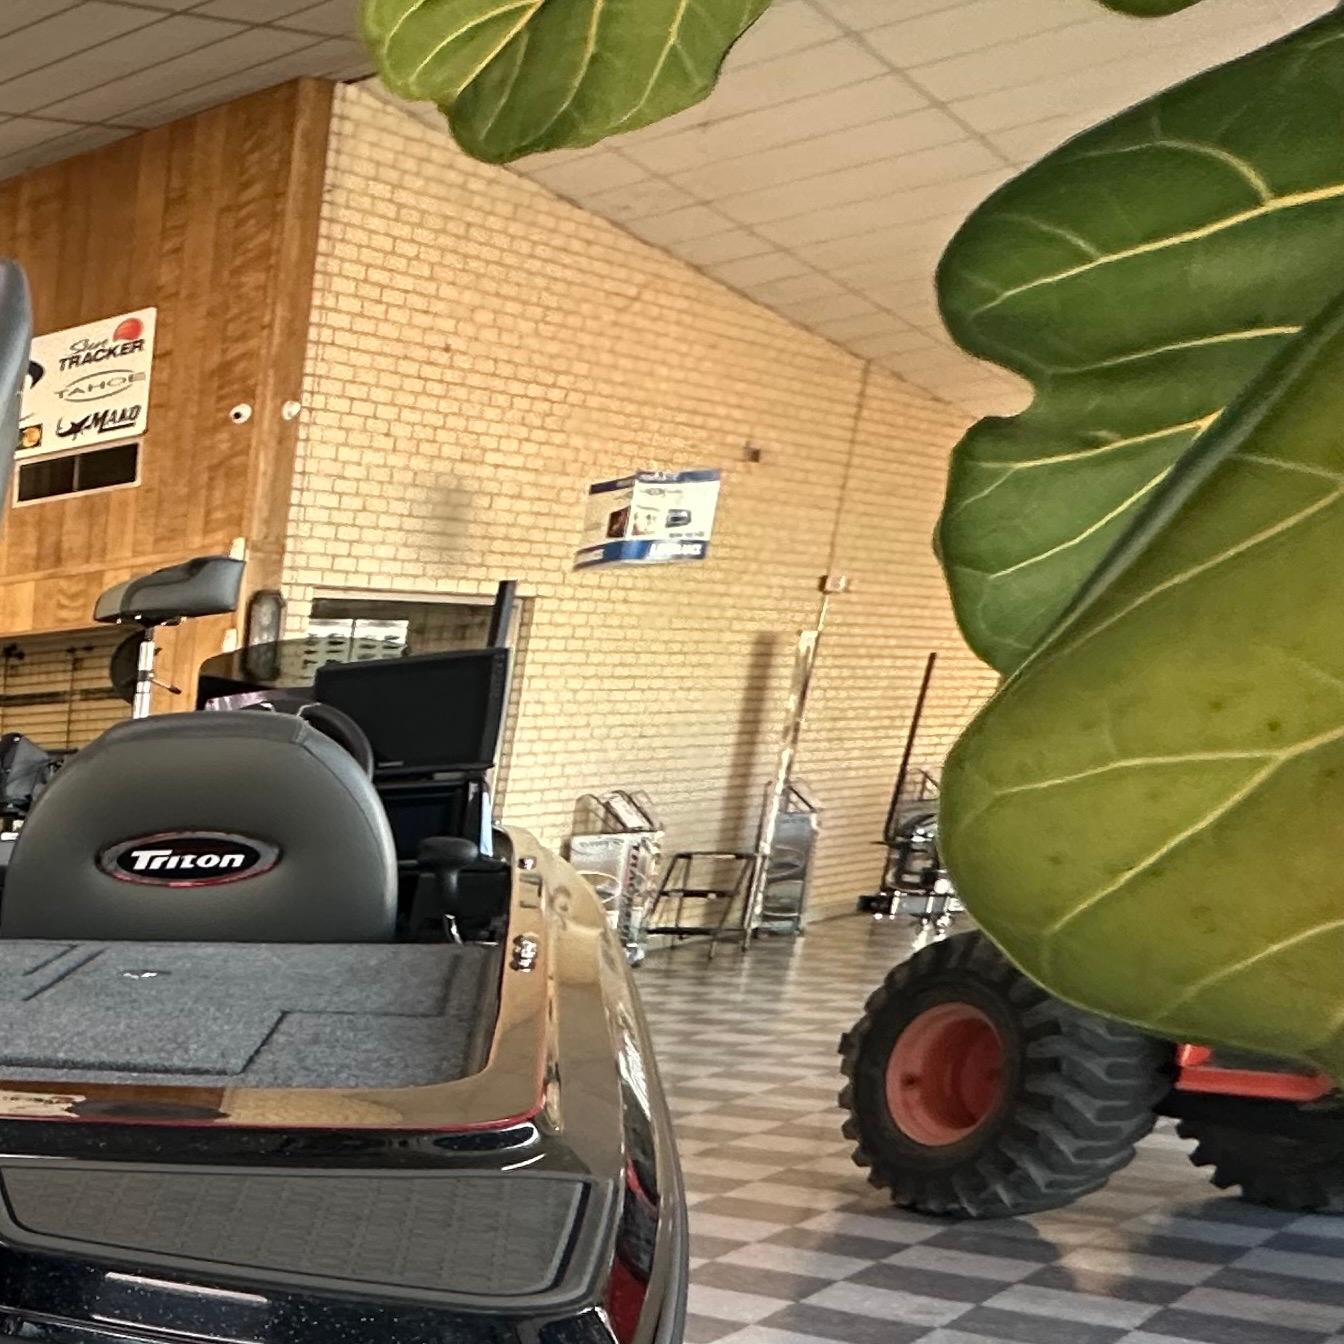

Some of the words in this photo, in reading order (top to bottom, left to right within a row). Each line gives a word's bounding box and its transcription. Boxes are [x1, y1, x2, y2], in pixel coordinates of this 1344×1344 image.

[59, 339, 144, 371] TRACKER
[54, 372, 146, 399] TAHOE
[131, 849, 245, 871] Triton
